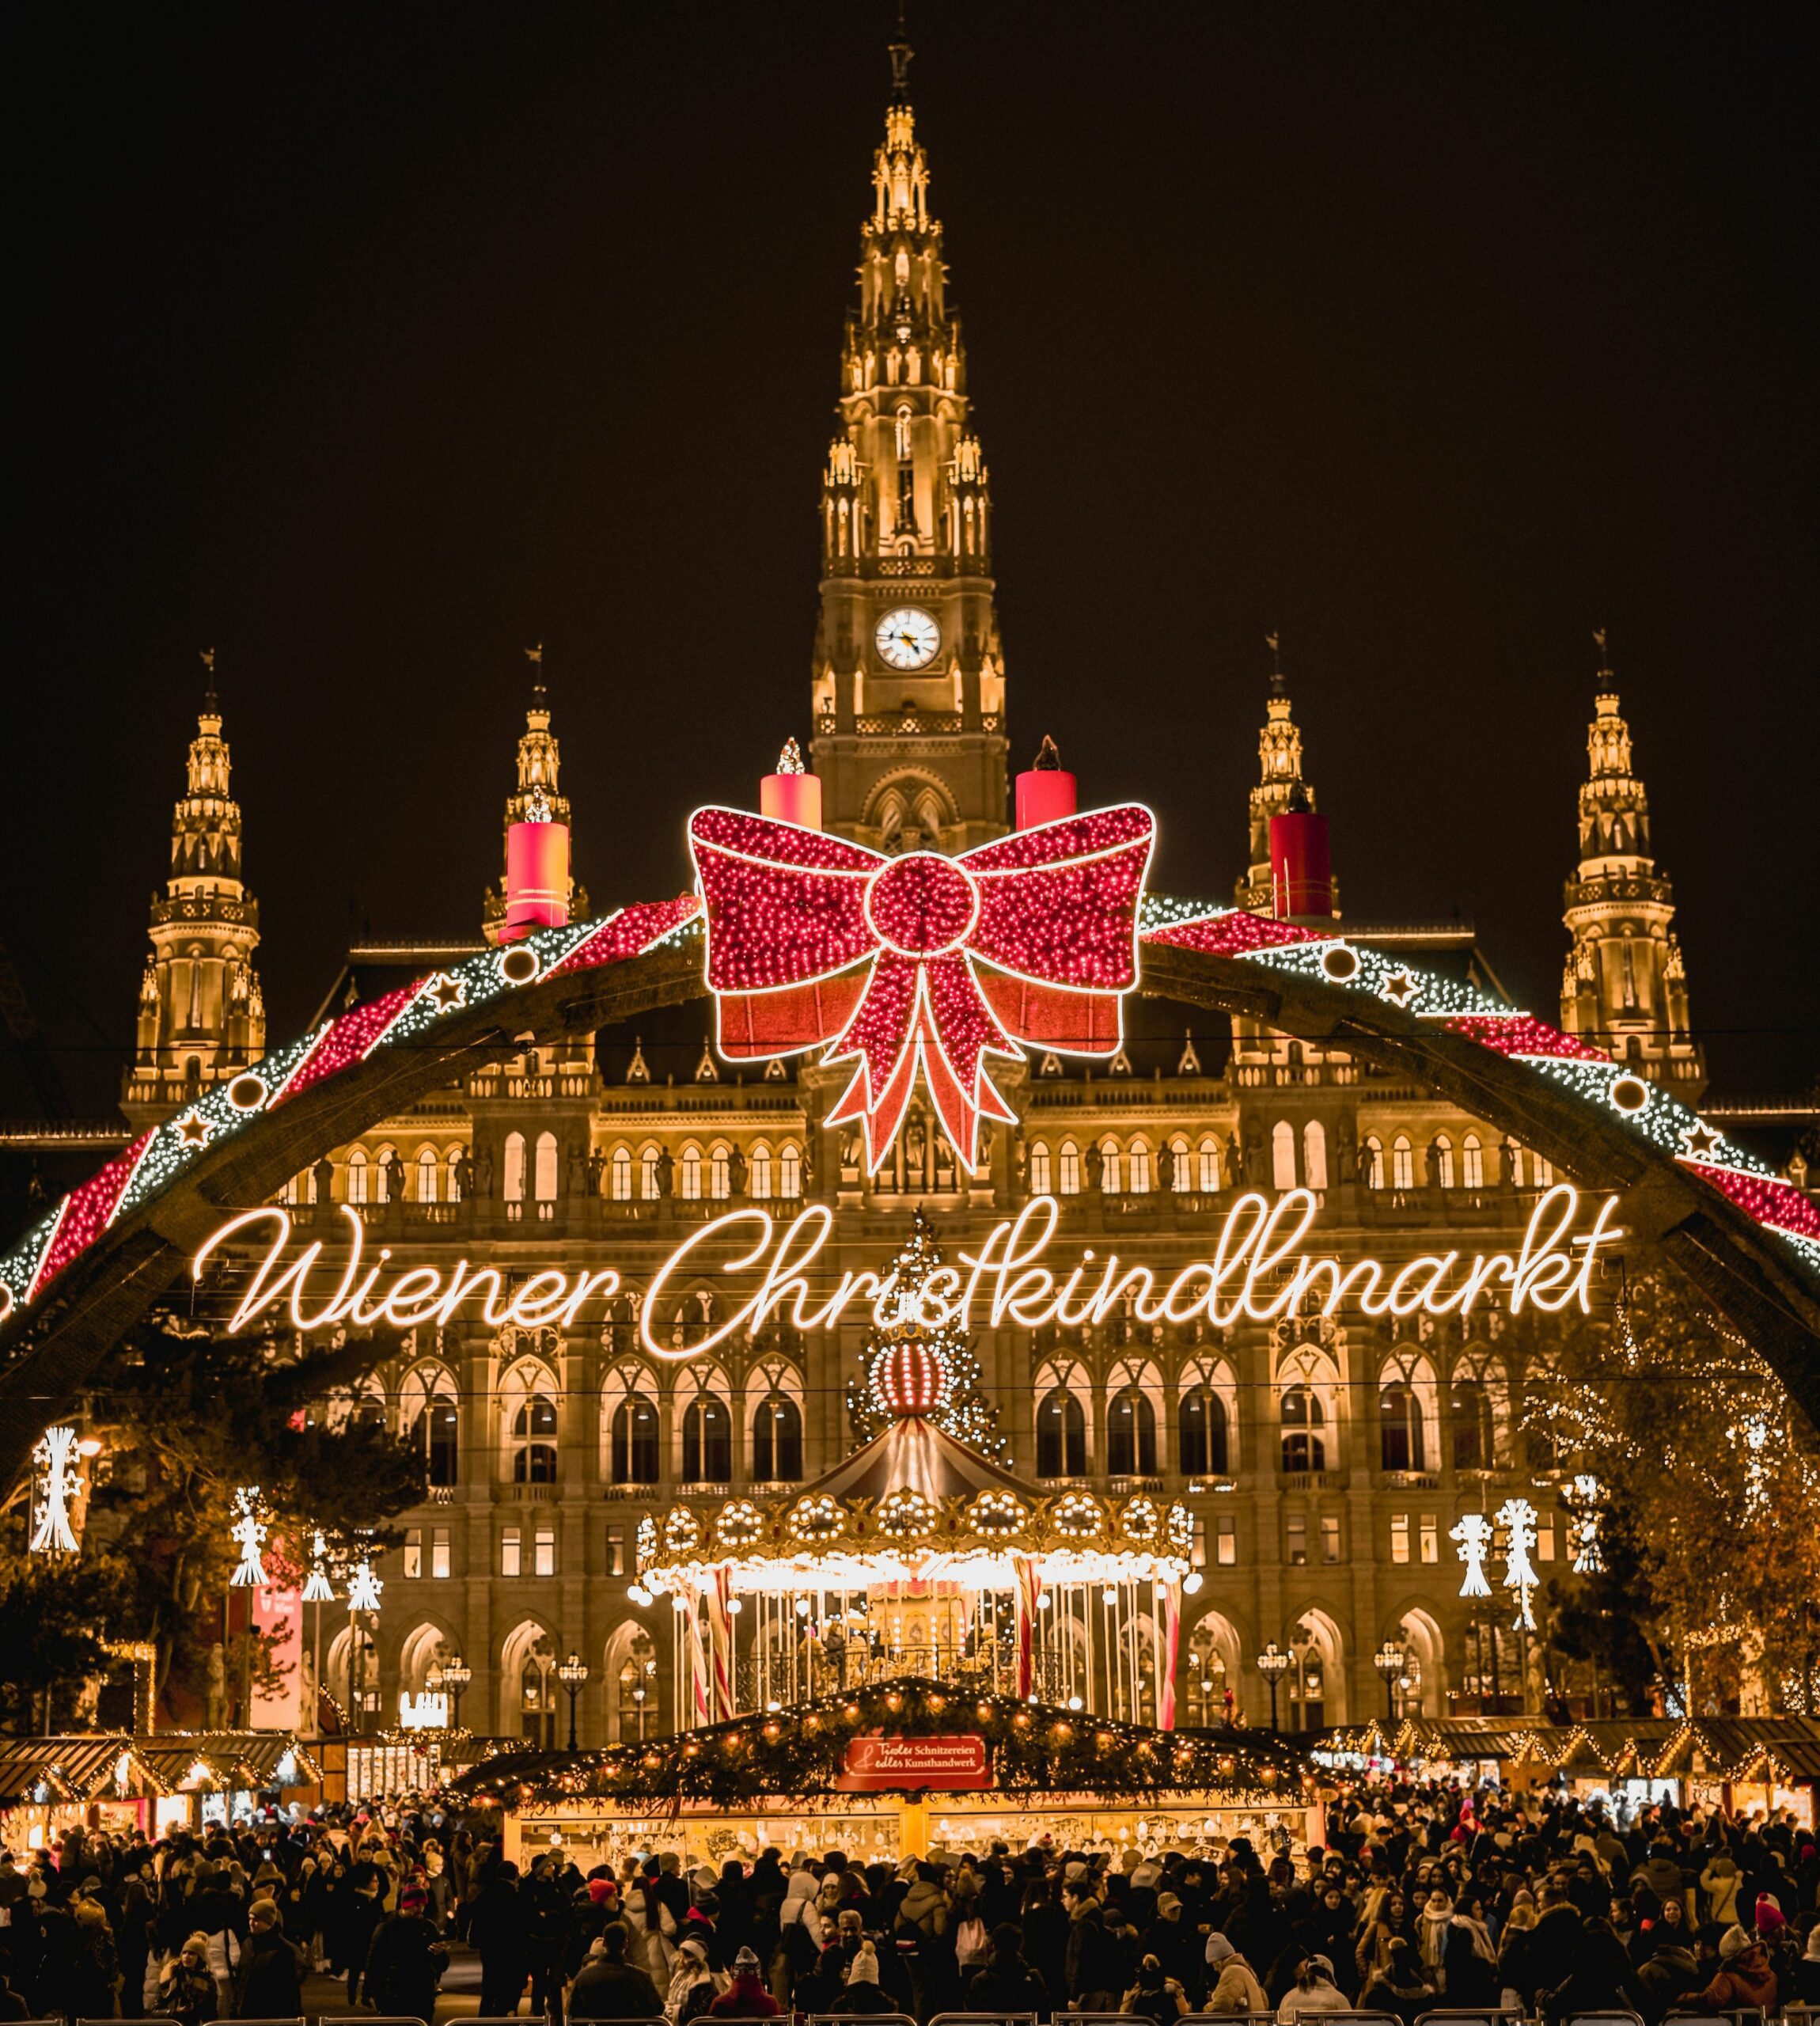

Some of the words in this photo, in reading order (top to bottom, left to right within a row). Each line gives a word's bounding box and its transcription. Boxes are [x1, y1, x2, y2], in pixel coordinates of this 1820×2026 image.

[191, 1203, 620, 1334] Wiener
[639, 1182, 1625, 1360] Christkindlmarkt
[877, 1743, 912, 1755] Tiroler
[914, 1745, 976, 1755] Schnitzereien
[874, 1755, 904, 1769] edles
[904, 1757, 976, 1768] Kunsthandwerk
